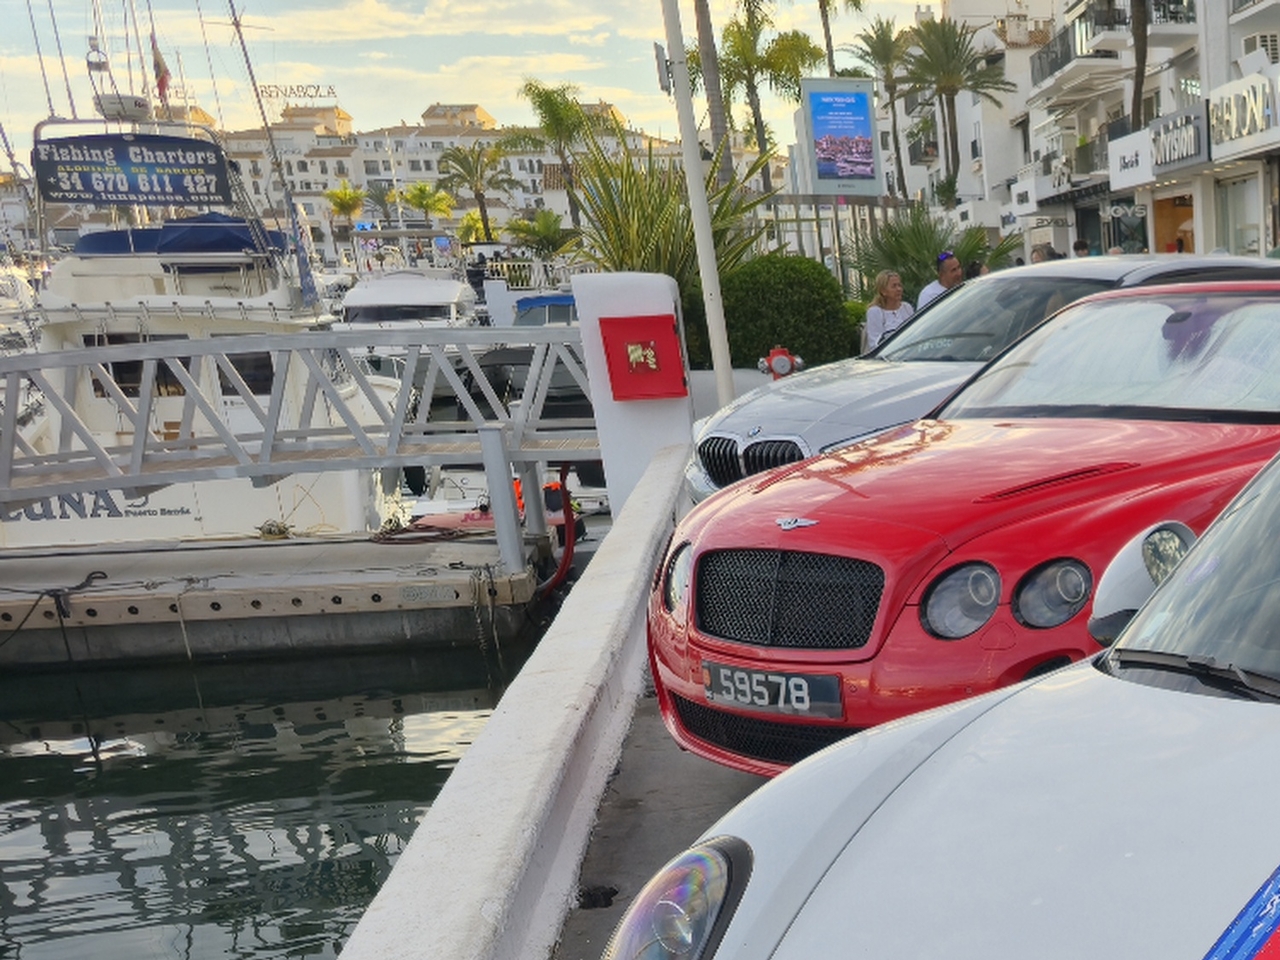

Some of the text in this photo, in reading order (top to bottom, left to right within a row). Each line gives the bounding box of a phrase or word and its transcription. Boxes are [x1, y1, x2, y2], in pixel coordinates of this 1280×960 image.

[259, 84, 338, 98] BENABOLA
[37, 144, 218, 167] Fishing Charters
[57, 165, 205, 175] ALQUILER DE BARCOS
[47, 172, 218, 194] +34 670 611 427
[1098, 203, 1147, 218] JOYS
[124, 509, 158, 518] Puerto
[719, 668, 810, 711] 59578
